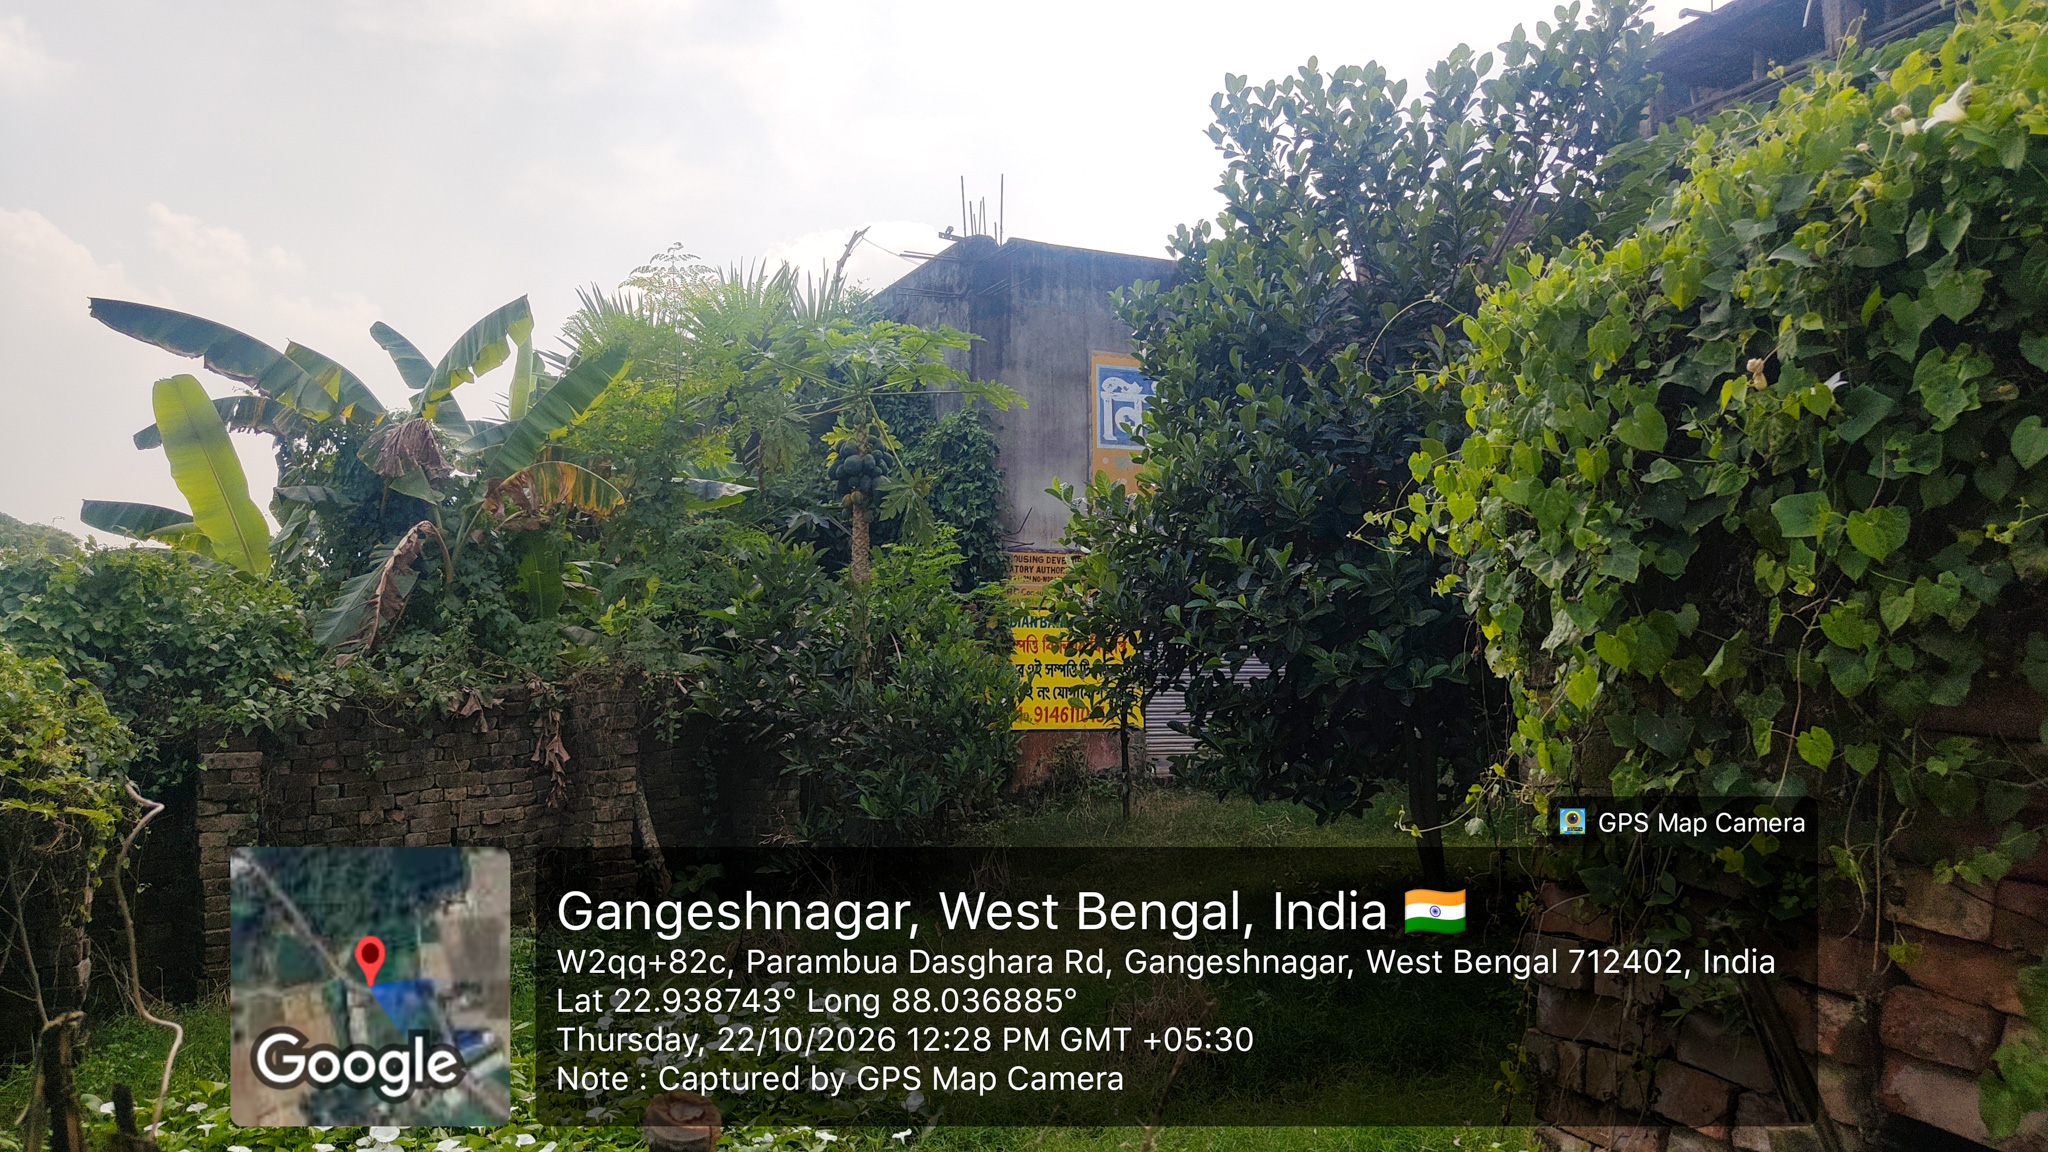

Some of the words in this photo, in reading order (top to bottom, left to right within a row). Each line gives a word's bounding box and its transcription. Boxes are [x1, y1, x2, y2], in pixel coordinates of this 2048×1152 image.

[1010, 555, 1044, 563] OUSING
[1006, 565, 1034, 573] ATORY
[1036, 566, 1067, 574] AUTHOR
